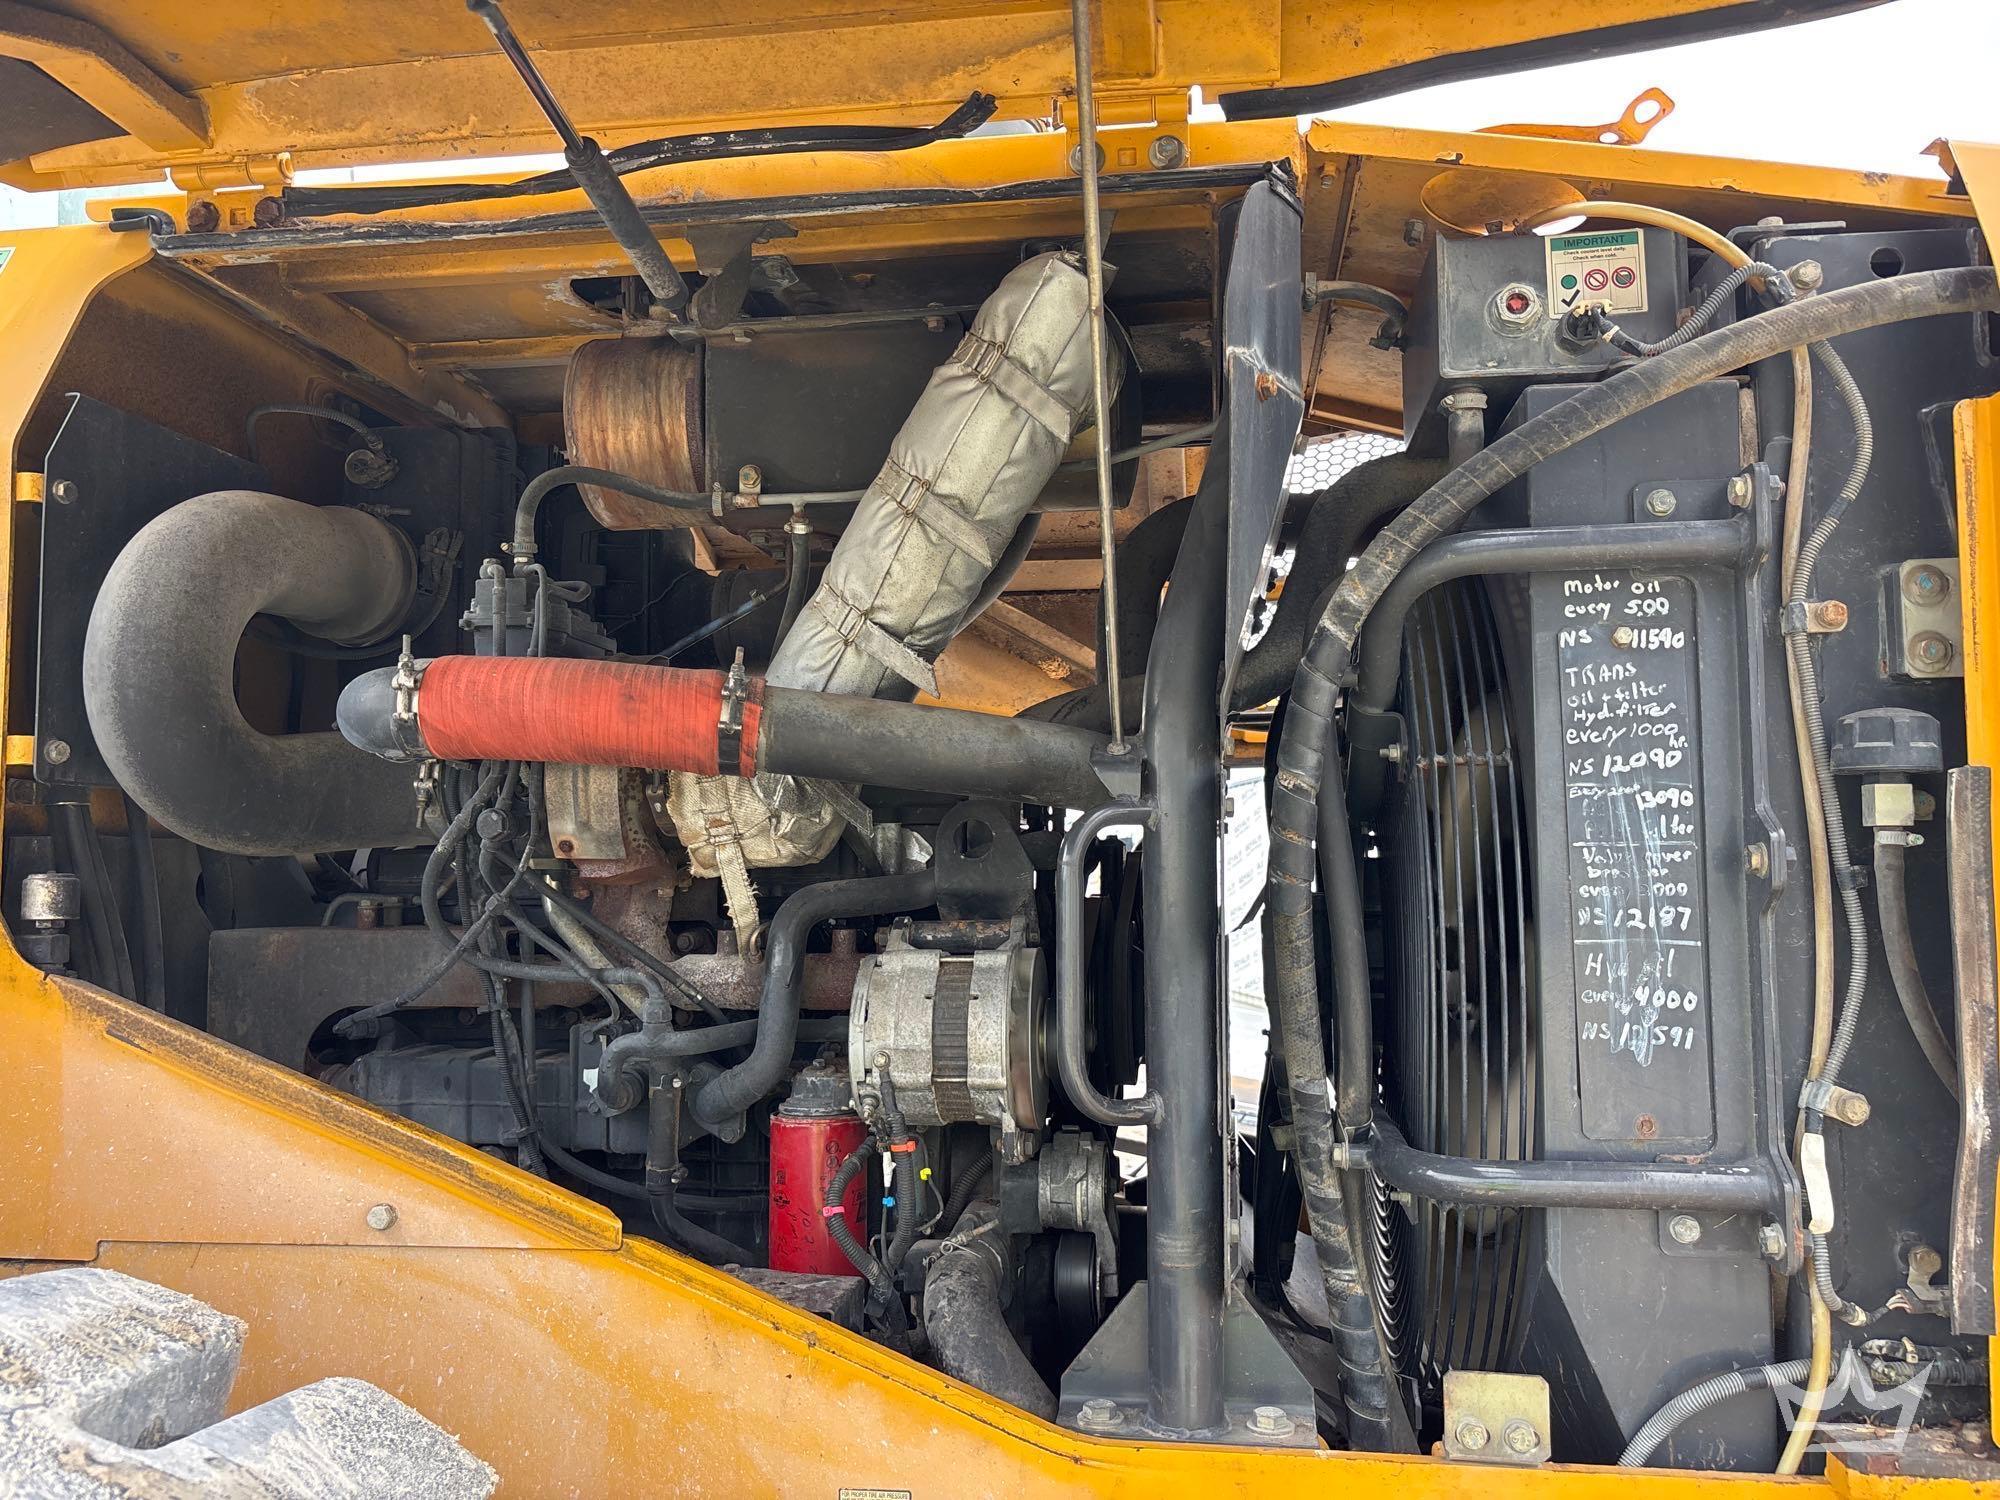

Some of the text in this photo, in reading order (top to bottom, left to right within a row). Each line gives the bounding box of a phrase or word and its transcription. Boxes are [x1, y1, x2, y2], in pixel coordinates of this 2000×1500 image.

[1563, 235, 1625, 248] IMPORTANT
[1564, 603, 1611, 620] every
[1560, 629, 1592, 648] NS
[1614, 680, 1667, 702] filter
[1566, 722, 1679, 748] every 1000
[1569, 747, 1682, 777] NS 12090
[1635, 788, 1694, 810] 13090
[1578, 905, 1691, 931] NS 12187
[1634, 985, 1698, 1012] 4000
[1582, 1021, 1611, 1040] NS
